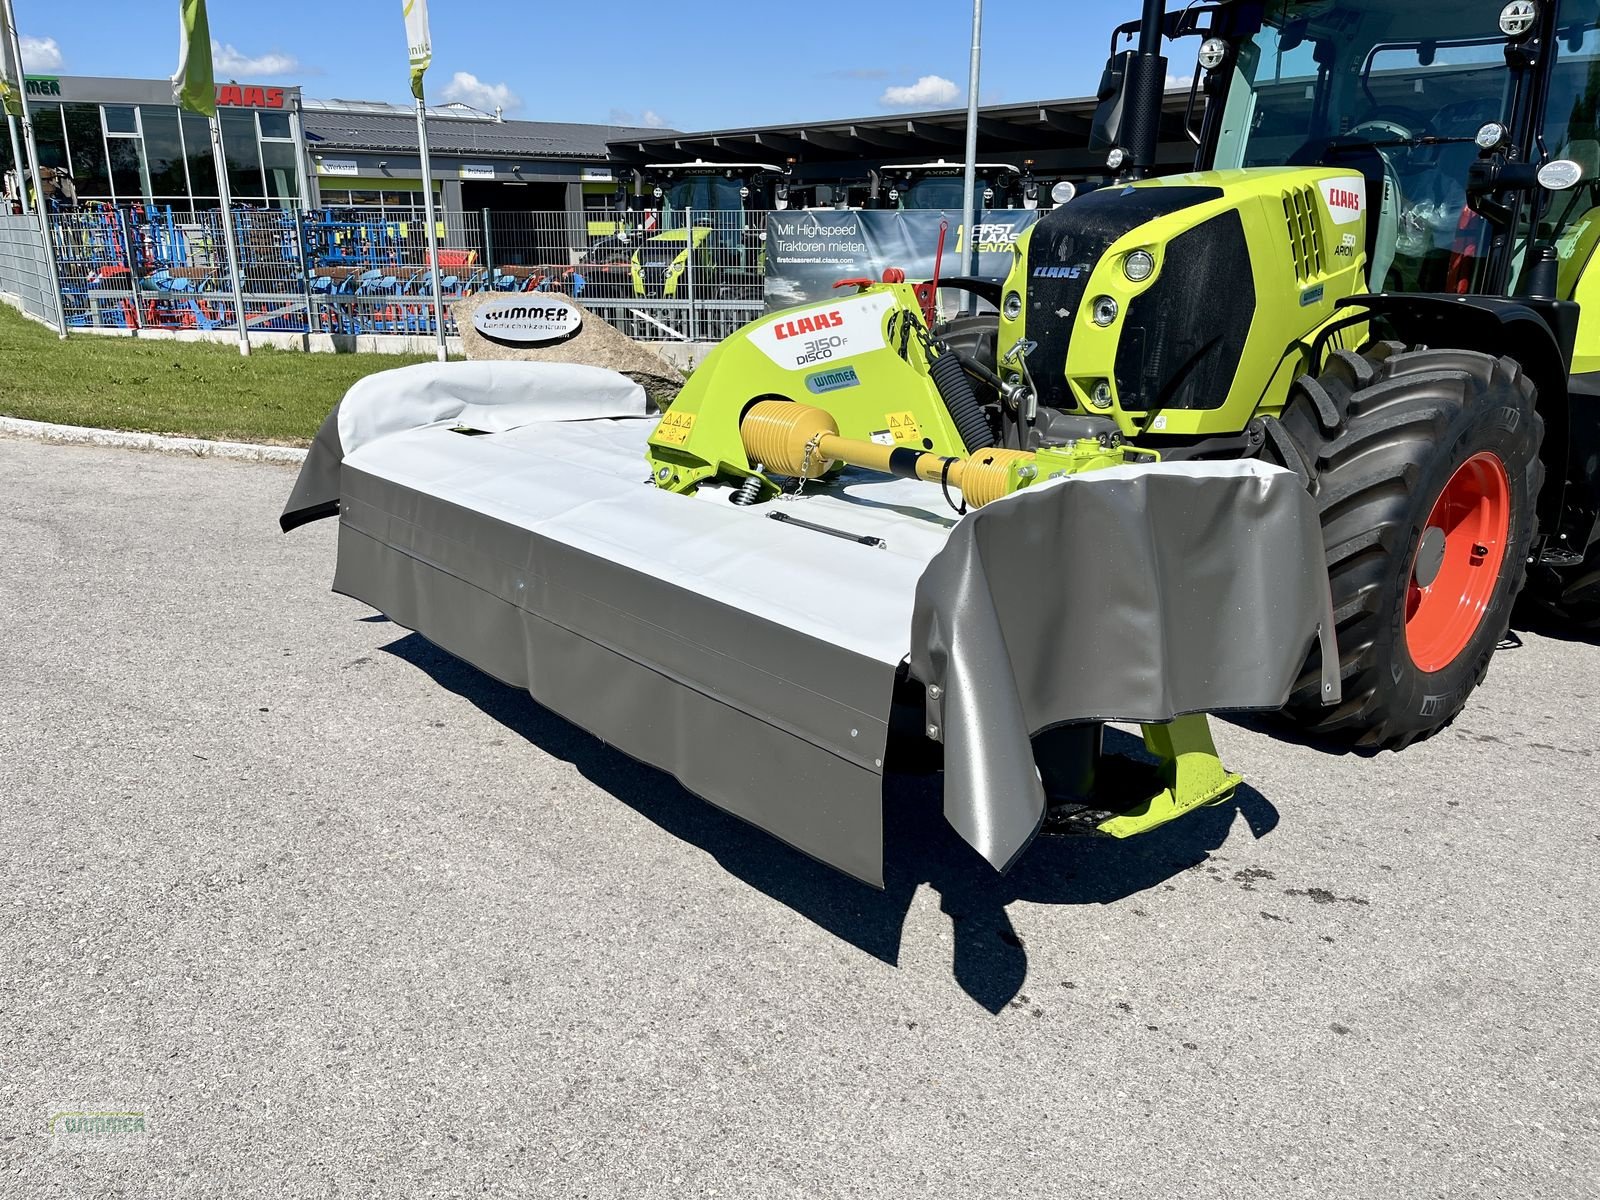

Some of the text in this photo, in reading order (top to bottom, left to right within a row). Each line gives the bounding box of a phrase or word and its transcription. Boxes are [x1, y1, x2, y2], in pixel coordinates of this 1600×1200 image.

[26, 80, 61, 96] MER
[215, 85, 284, 109] AAS
[1329, 188, 1359, 210] CLAAS
[778, 223, 857, 238] Mit Highspeed
[971, 223, 1015, 234] FIRST
[777, 240, 868, 252] Traktoren mieten.
[971, 242, 1015, 253] RENTA
[1334, 245, 1354, 257] ARION
[776, 256, 854, 264] firstclaasrental.claas.com
[1033, 266, 1081, 279] CLAAS
[485, 307, 569, 321] WIMMER
[774, 311, 844, 340] CLAAS
[796, 349, 833, 366] DISCO
[813, 370, 857, 388] WIMMER
